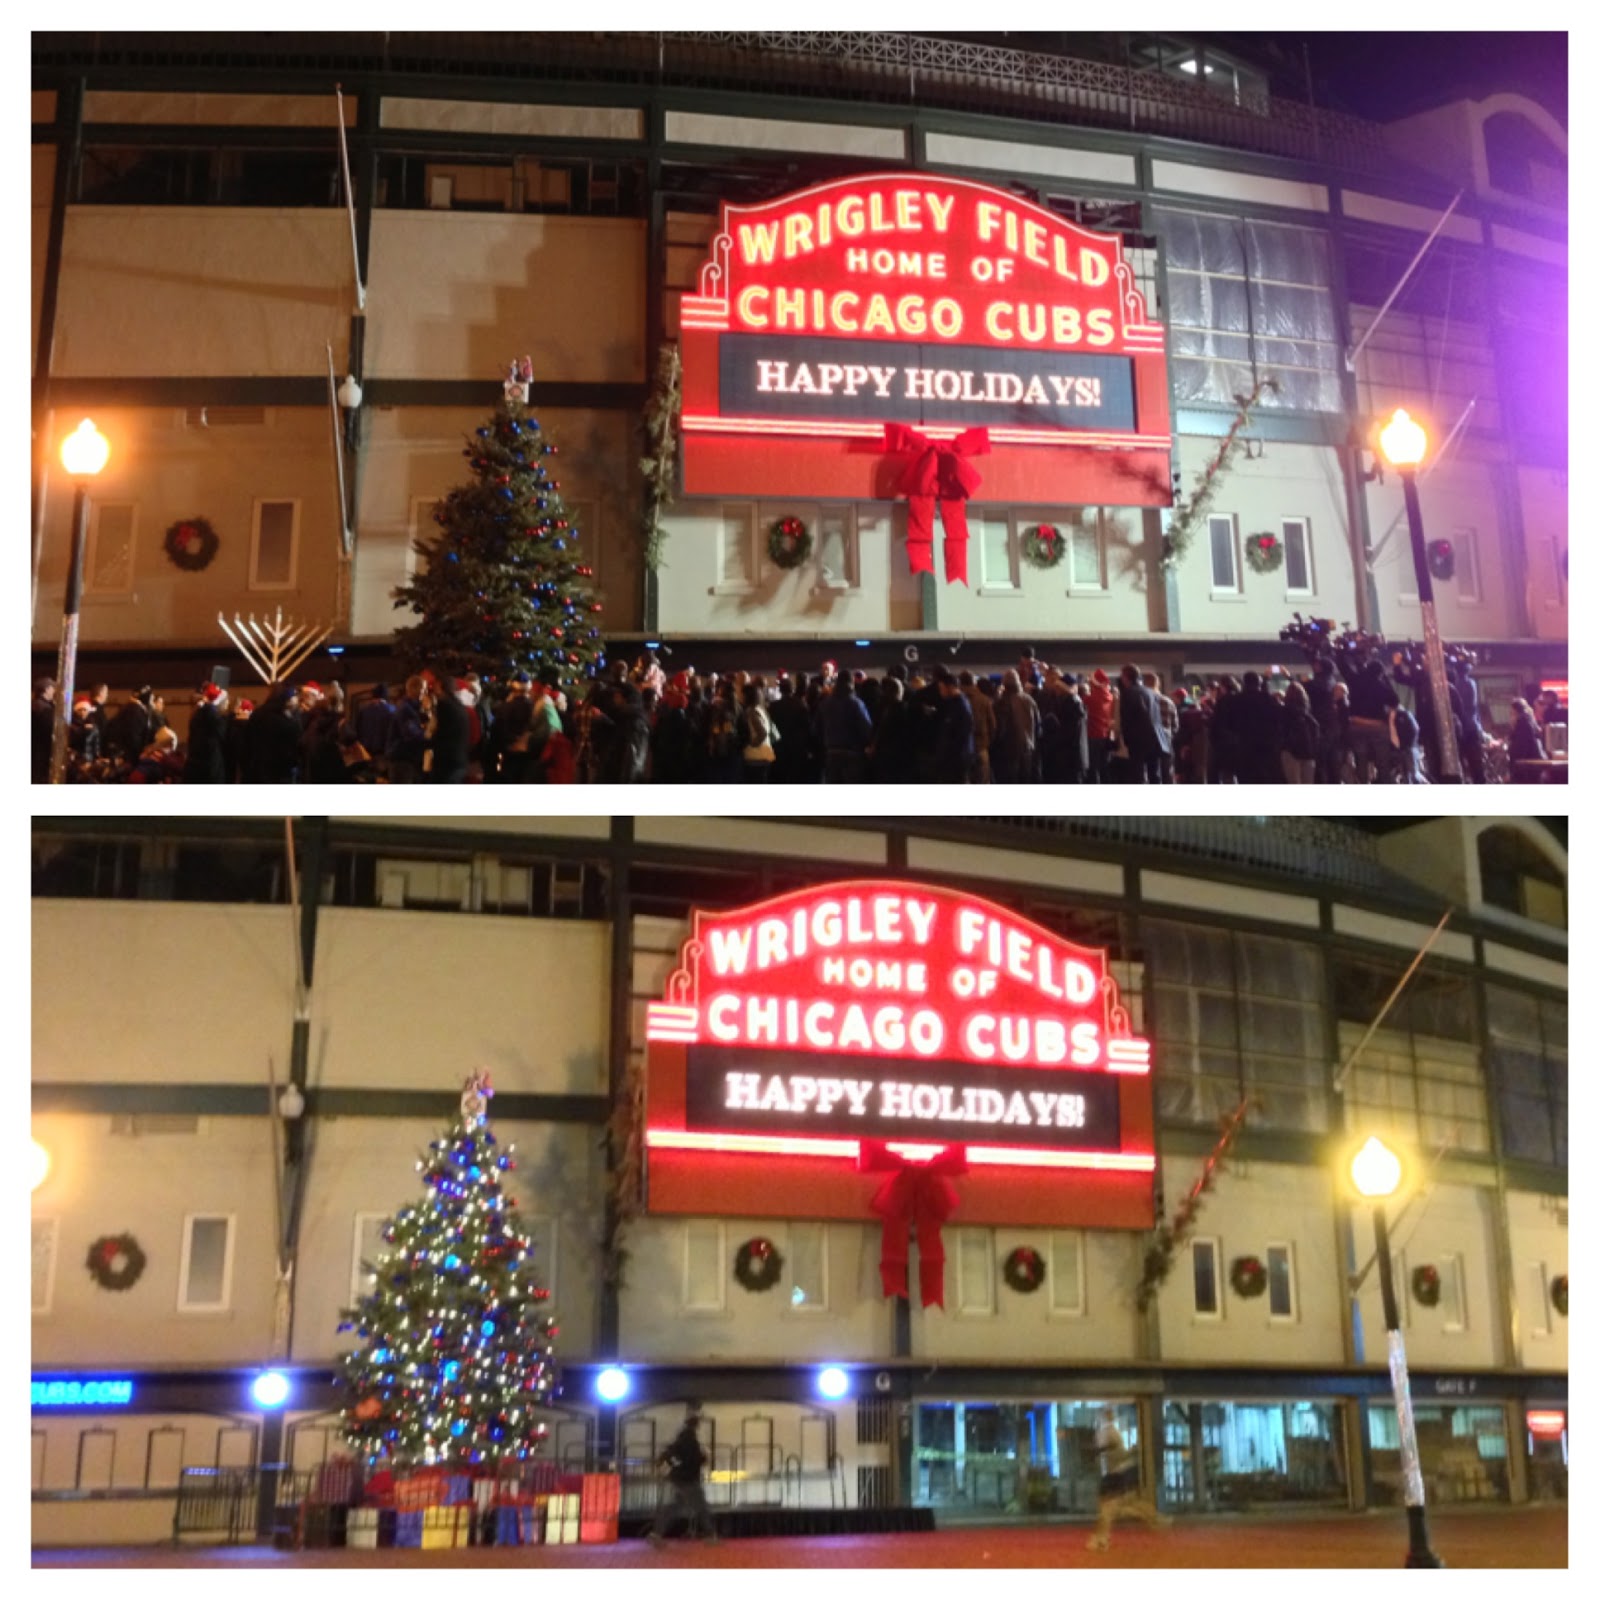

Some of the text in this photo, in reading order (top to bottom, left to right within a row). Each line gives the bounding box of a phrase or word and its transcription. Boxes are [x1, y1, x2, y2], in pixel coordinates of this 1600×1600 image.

[737, 189, 1110, 288] WRIGLEY FIELD
[846, 247, 1015, 283] HOME OF
[737, 284, 1116, 347] CHICAGO CUBS
[756, 359, 1102, 408] HAPPY HOLIDAYS!
[904, 644, 920, 662] G
[708, 896, 1098, 1004] WRIGLEY FIELD
[820, 956, 1001, 998] HOME OF
[706, 992, 1102, 1066] CHICAGO CUBS
[724, 1072, 1086, 1129] HAPPY HOLIDAYS!
